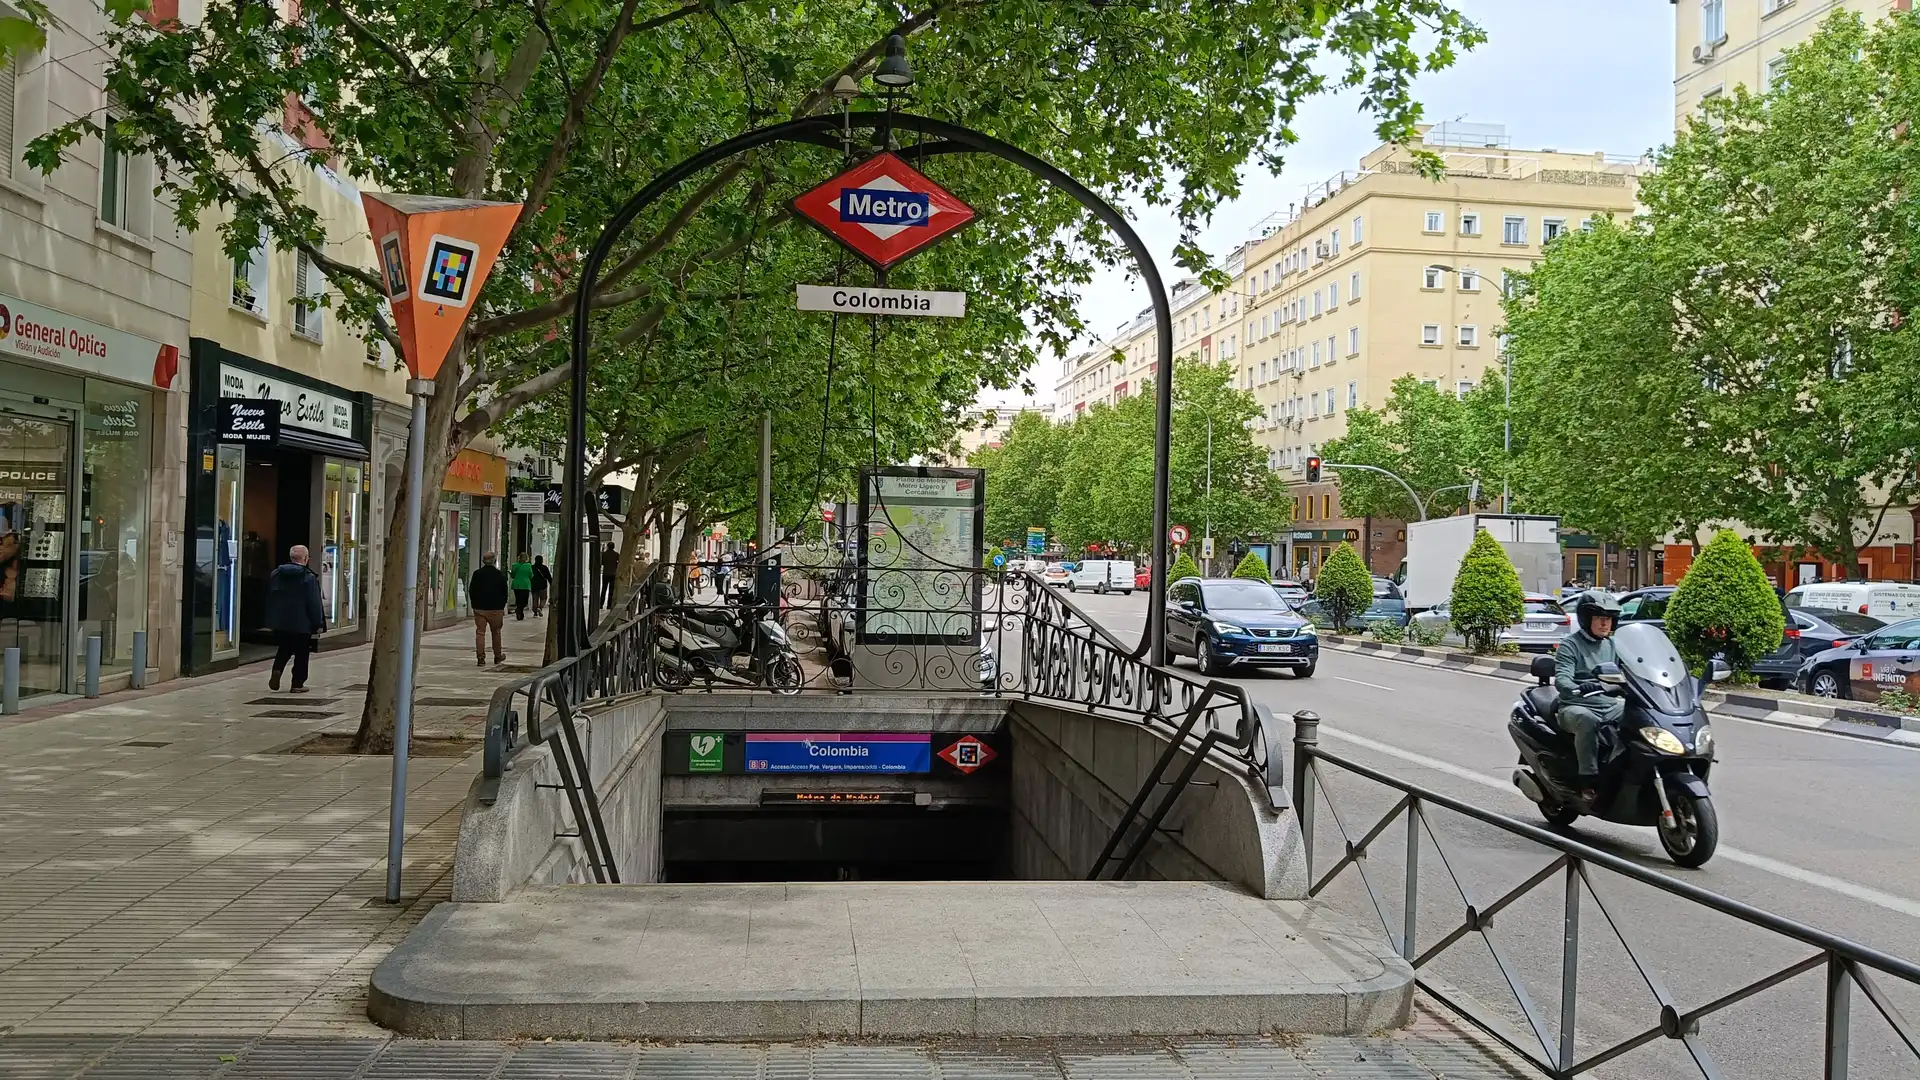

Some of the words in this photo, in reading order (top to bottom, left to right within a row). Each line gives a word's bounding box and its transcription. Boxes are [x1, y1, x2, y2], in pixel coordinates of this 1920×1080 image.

[849, 194, 922, 219] Metro
[832, 291, 931, 310] Colombia
[15, 314, 66, 347] General
[70, 330, 107, 358] Optica
[15, 340, 33, 352] Visión
[37, 345, 60, 358] Audición
[224, 374, 244, 390] MODA
[230, 404, 265, 417] Nuevo
[296, 394, 324, 423] Estilo
[334, 404, 347, 416] MODA
[232, 418, 266, 430] Estilo
[332, 417, 348, 430] MUJER
[0, 472, 56, 480] POLICE
[1873, 673, 1906, 684] INFINITO
[809, 745, 869, 757] Colombia
